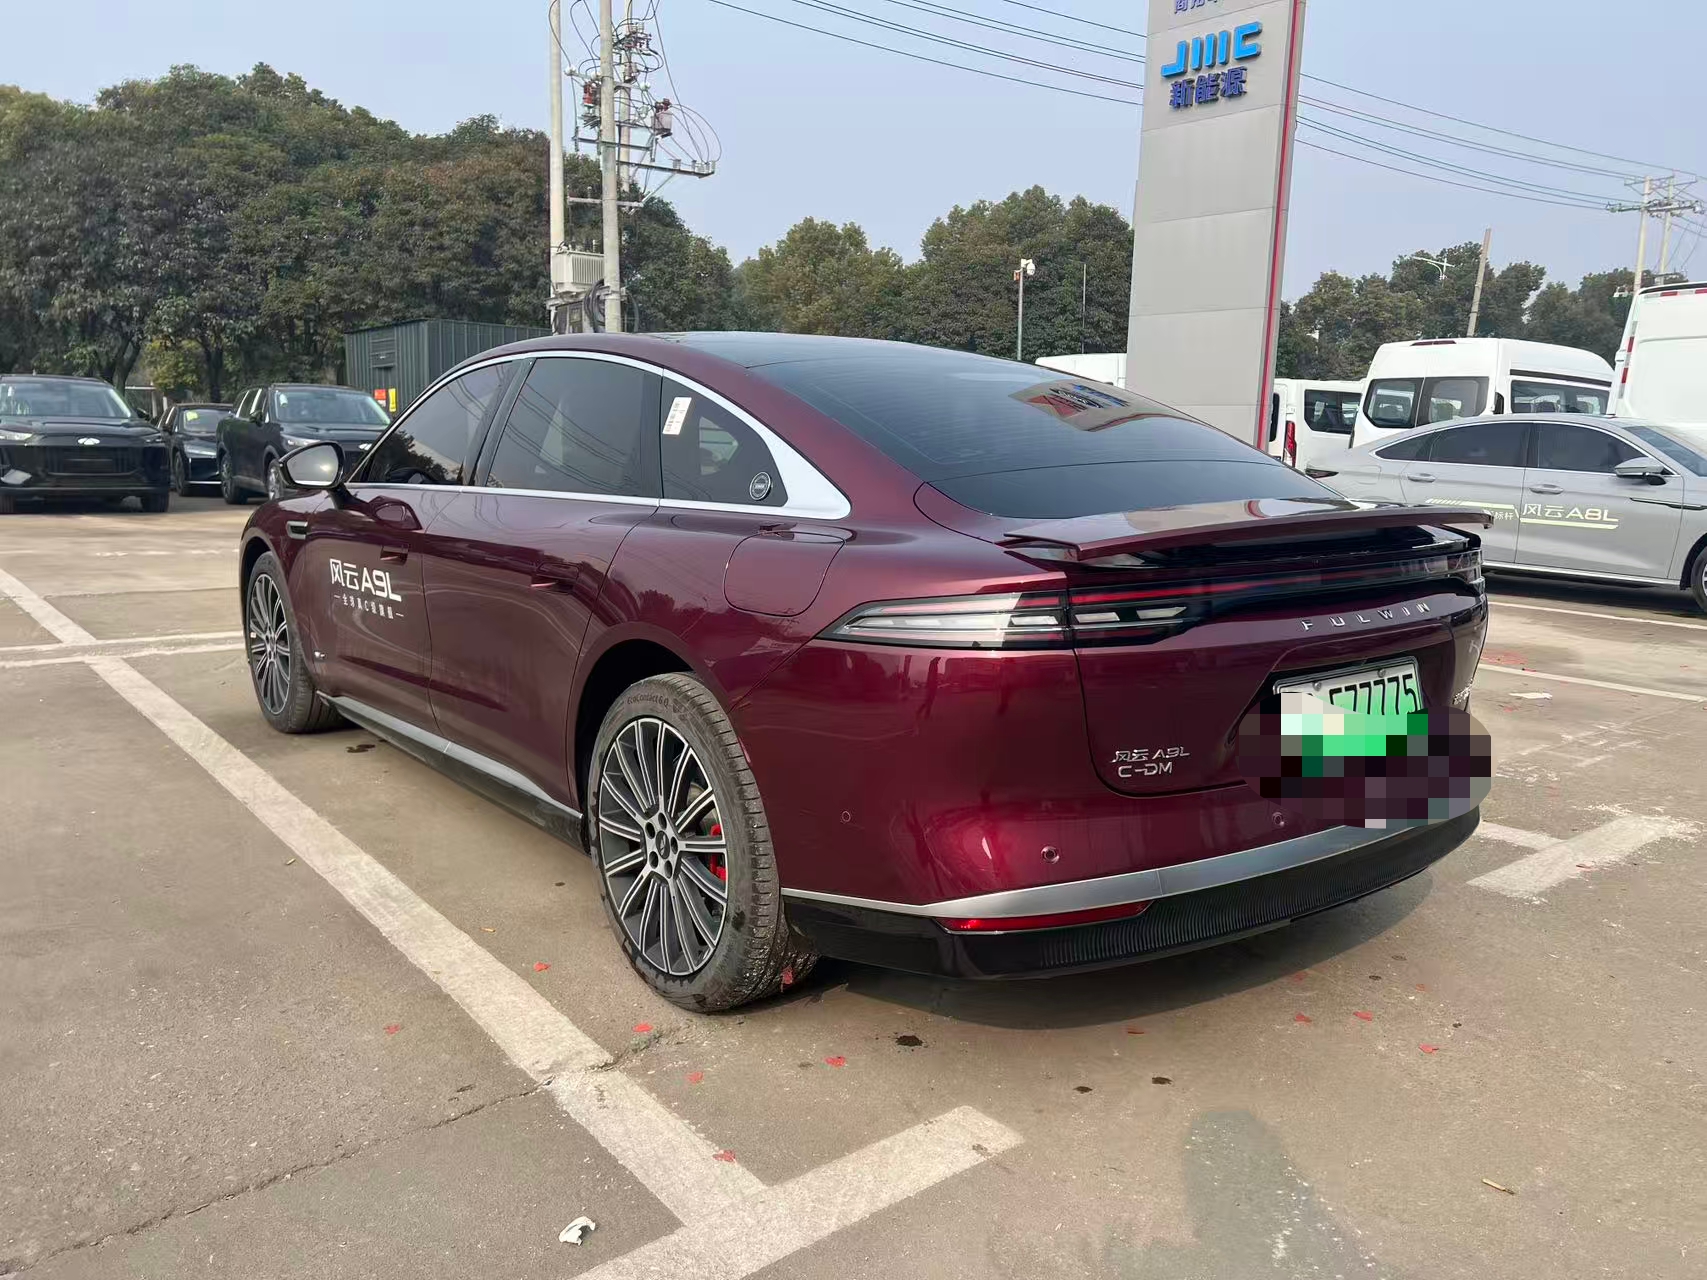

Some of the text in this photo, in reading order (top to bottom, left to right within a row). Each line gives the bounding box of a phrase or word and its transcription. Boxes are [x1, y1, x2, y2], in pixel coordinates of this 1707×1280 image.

[1160, 21, 1263, 77] JMC
[1169, 66, 1248, 109] 新能源
[1523, 503, 1619, 523] 风云A8L
[330, 558, 402, 602] 风云A9L
[1301, 602, 1431, 631] FULWIN
[1118, 761, 1173, 778] C-DM
